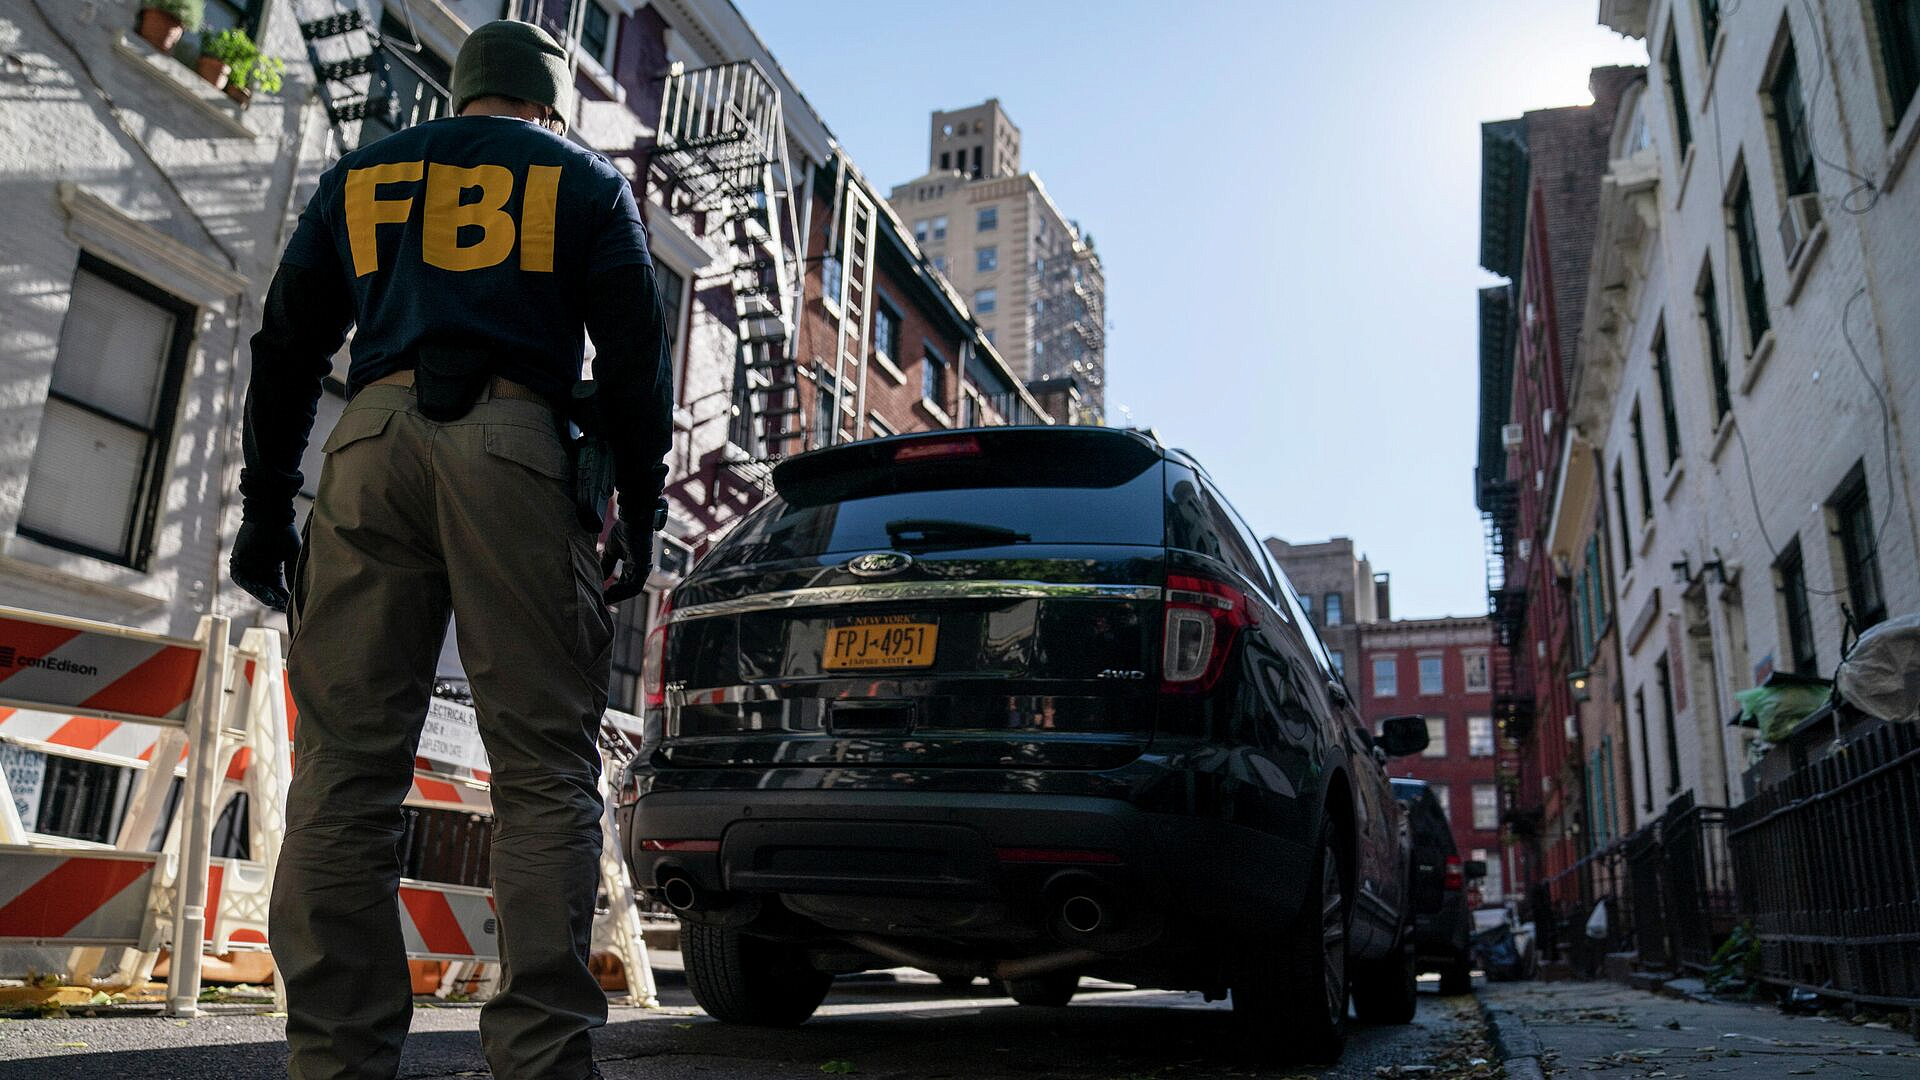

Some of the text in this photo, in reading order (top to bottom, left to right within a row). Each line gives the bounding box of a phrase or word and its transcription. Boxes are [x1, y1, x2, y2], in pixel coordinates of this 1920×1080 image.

[344, 159, 563, 279] FBI
[860, 553, 897, 570] Ford
[855, 614, 911, 625] NEW YORK
[17, 656, 98, 676] conEdison
[429, 703, 467, 723] LECTRICAL
